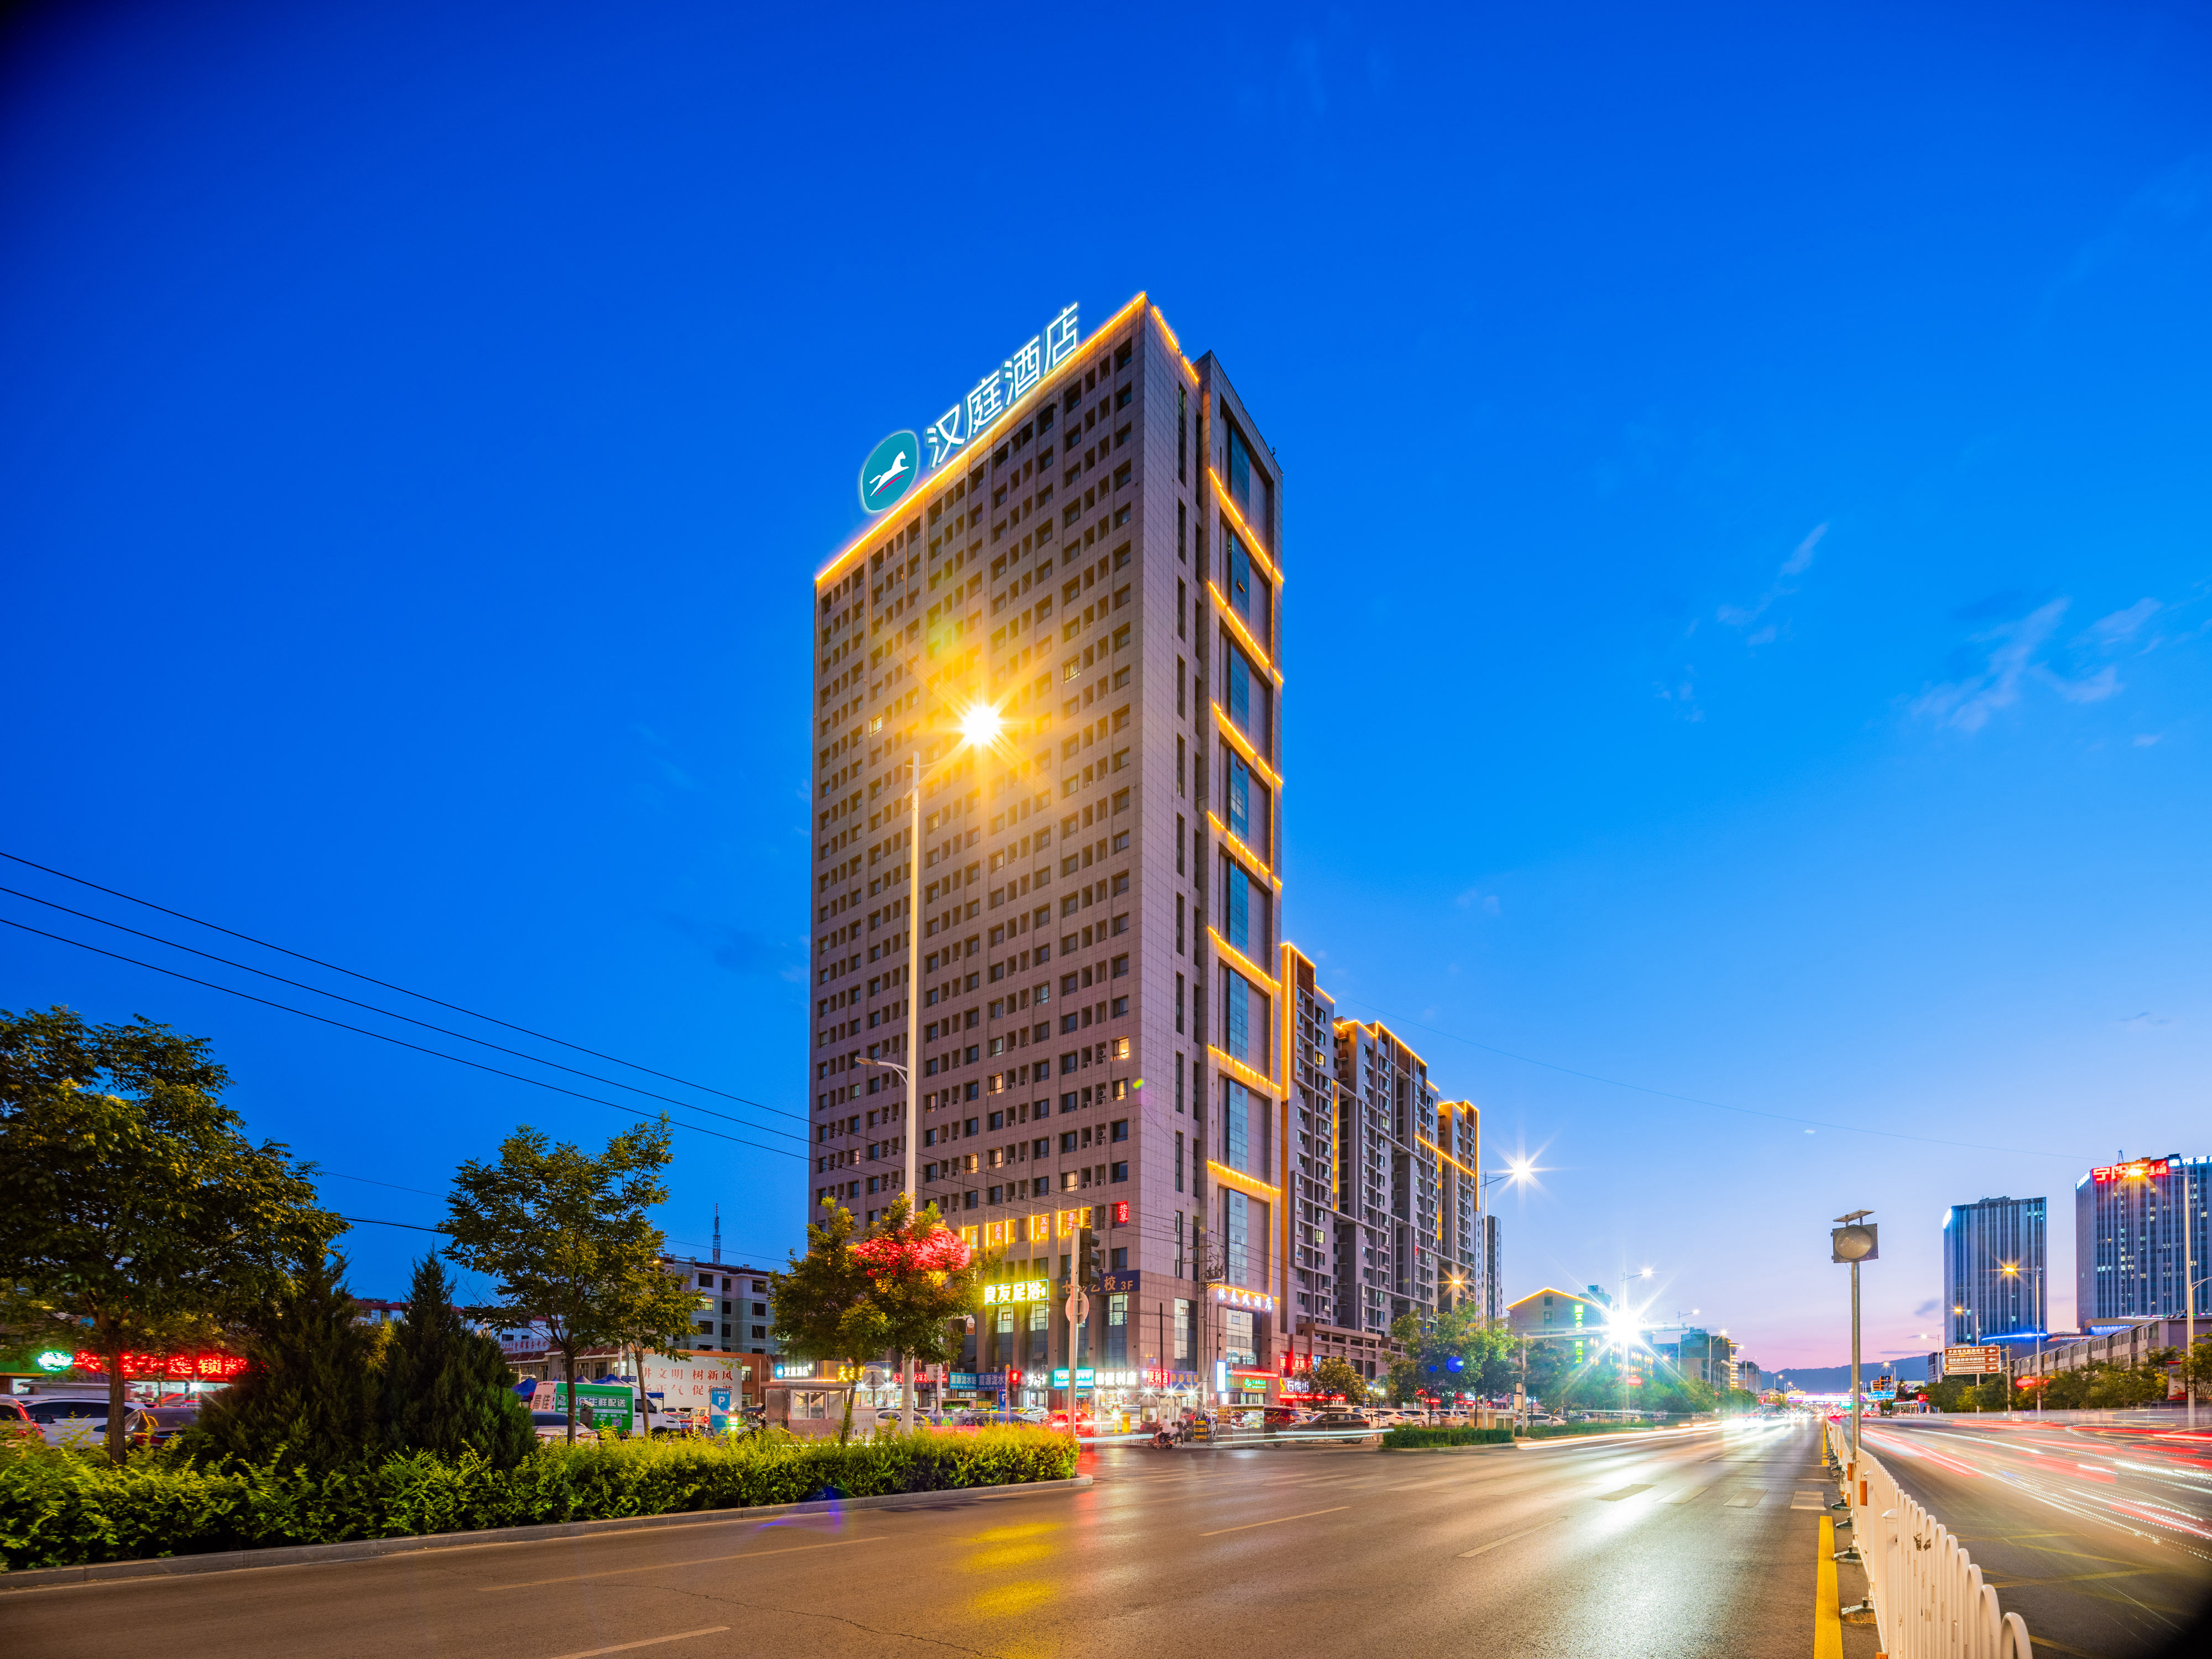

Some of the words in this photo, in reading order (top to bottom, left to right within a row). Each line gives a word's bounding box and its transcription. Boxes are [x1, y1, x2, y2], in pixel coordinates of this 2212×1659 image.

[926, 302, 1078, 469] 汉庭酒店
[995, 1224, 1001, 1240] 良友
[1040, 1217, 1047, 1234] 足浴
[1121, 1280, 1133, 1290] 3F
[984, 1282, 1041, 1303] 良友足浴
[643, 1367, 684, 1380] 讲文明
[692, 1369, 733, 1381] 树新风
[979, 1374, 1006, 1386] 震源泷水
[1147, 1371, 1168, 1384] 便利店
[718, 1396, 726, 1405] P
